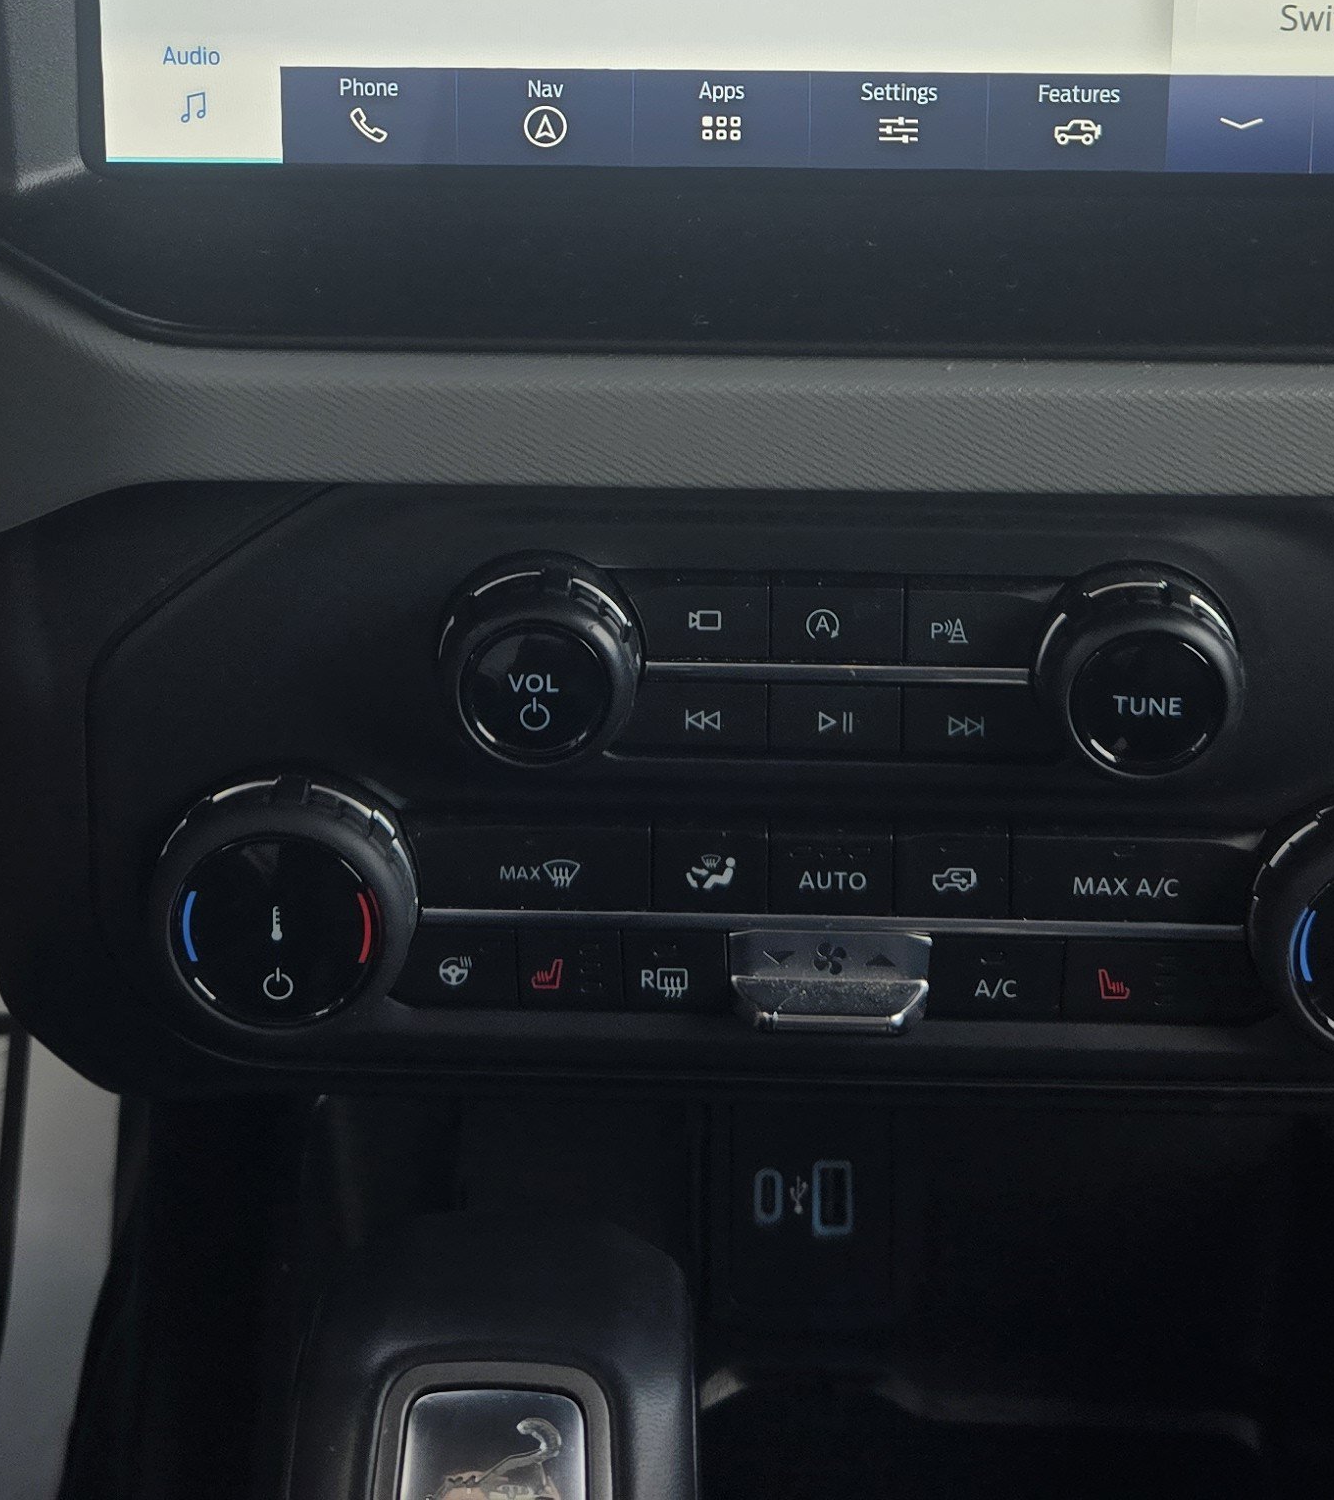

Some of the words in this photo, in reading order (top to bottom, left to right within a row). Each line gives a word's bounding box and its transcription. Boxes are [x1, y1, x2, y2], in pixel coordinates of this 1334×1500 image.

[163, 46, 220, 65] Audio
[340, 78, 398, 96] Phone
[528, 80, 563, 97] Nav
[699, 81, 744, 102] Apps
[861, 83, 937, 104] Settings
[1039, 85, 1120, 103] Features
[508, 674, 558, 692] VOL
[1113, 695, 1181, 716] TUNE
[500, 866, 540, 880] MAX
[799, 871, 866, 890] AUTO
[1074, 877, 1127, 895] MAX
[1136, 878, 1178, 897] A/C
[975, 979, 1016, 998] A/C
